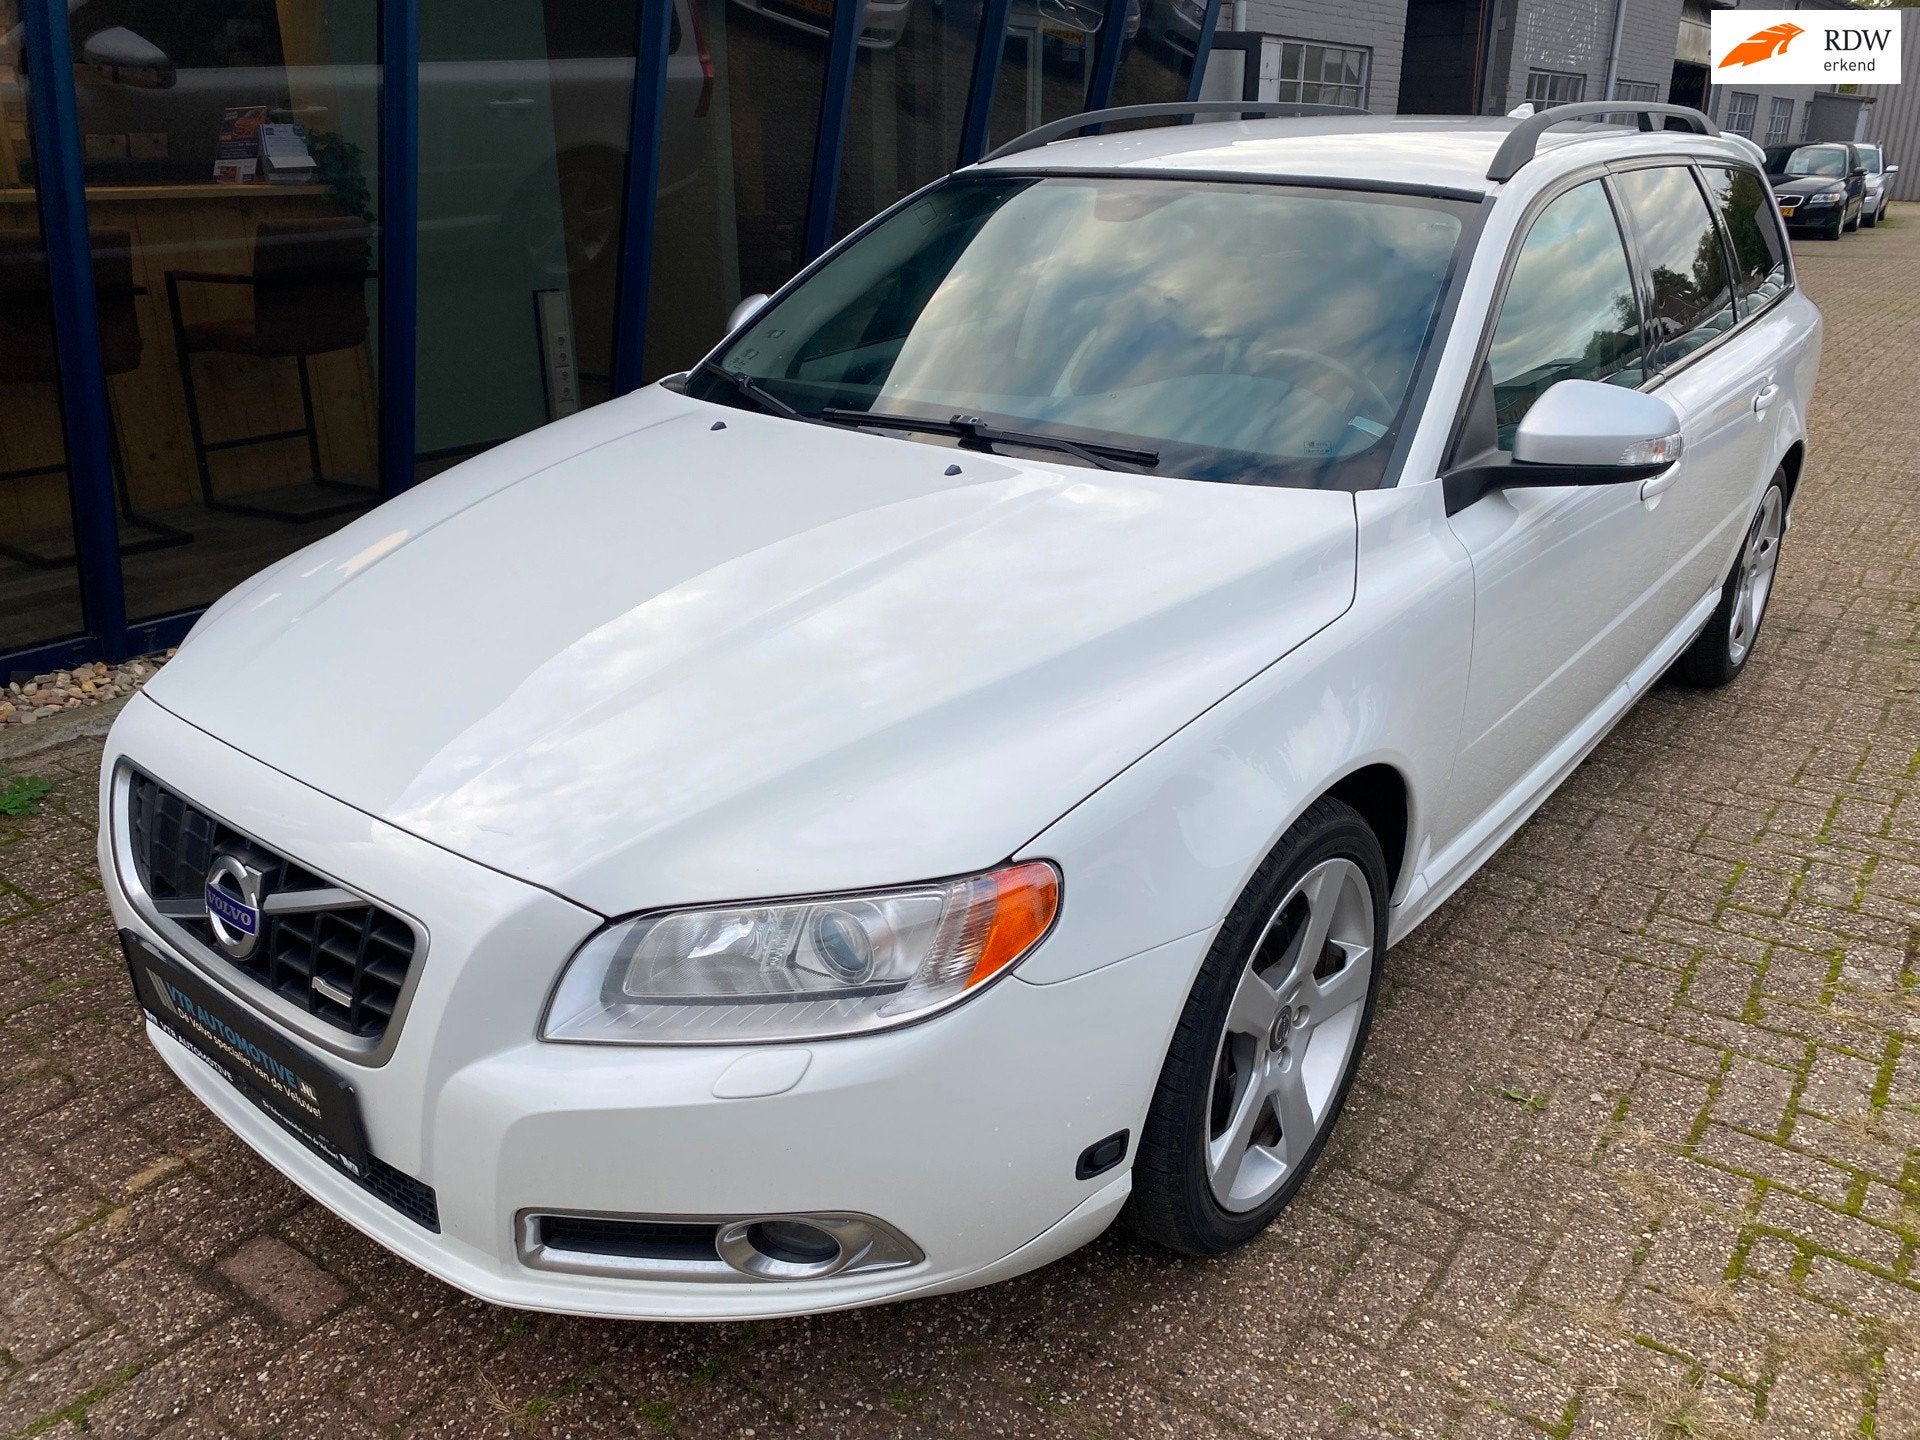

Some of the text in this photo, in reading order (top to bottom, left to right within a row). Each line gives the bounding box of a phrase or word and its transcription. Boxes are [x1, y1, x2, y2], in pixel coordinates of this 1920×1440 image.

[207, 889, 252, 926] VOLVO
[166, 981, 196, 1016] VTR
[177, 1007, 190, 1023] De
[190, 1016, 213, 1040] Volvo
[213, 1035, 253, 1070] specialist
[253, 1064, 270, 1083] van
[270, 1078, 283, 1092] de
[283, 1084, 322, 1119] Veluwe!
